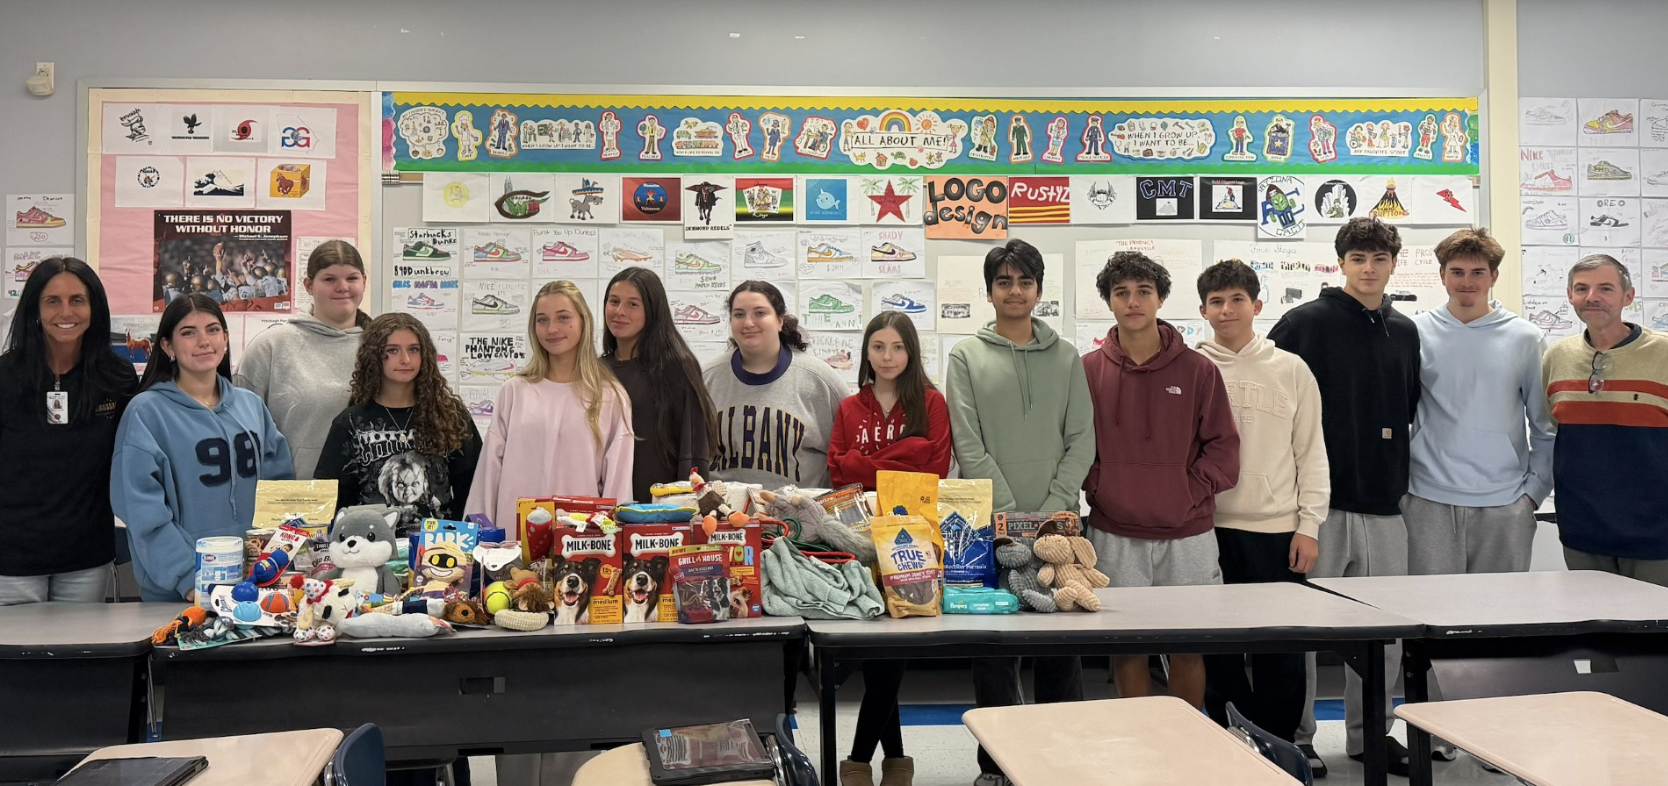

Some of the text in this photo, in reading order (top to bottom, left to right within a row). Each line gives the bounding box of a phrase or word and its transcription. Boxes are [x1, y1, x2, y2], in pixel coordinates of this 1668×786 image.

[854, 135, 947, 147] ALL ABOUT ME!
[1139, 139, 1161, 147] WANT
[1521, 148, 1544, 161] NIKE
[928, 177, 1008, 203] LOGO
[1139, 179, 1193, 199] CMT
[163, 215, 284, 223] THERE IS NO VICTORY
[923, 201, 1008, 234] design
[175, 225, 272, 233] WITHOUT HONOR
[469, 336, 513, 346] THE NIKE
[465, 345, 508, 353] PHANTOM
[998, 521, 1035, 531] 2 PIXEL
[280, 532, 295, 541] KONG
[425, 532, 470, 549] BARK
[678, 554, 723, 565] GRILL HOUSE
[891, 549, 926, 565] TRUE
[897, 562, 923, 571] CHEWS
